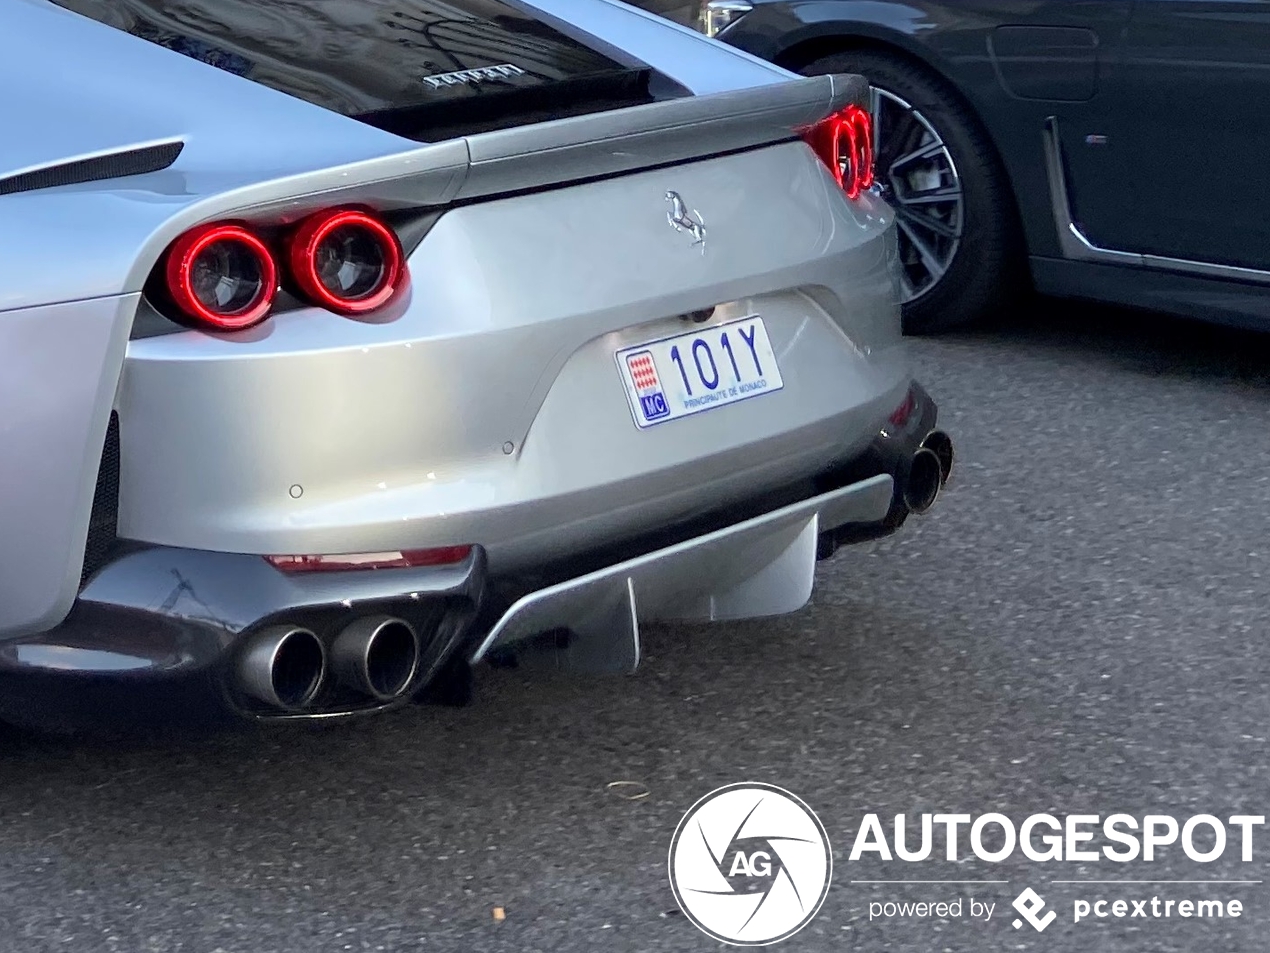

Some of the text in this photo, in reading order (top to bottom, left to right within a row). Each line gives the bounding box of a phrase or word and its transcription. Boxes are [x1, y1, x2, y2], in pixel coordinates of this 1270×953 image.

[423, 64, 526, 90] FERRARI
[671, 325, 763, 396] 101Y
[729, 386, 739, 397] DE
[740, 379, 767, 395] MONACO
[643, 394, 666, 417] MC
